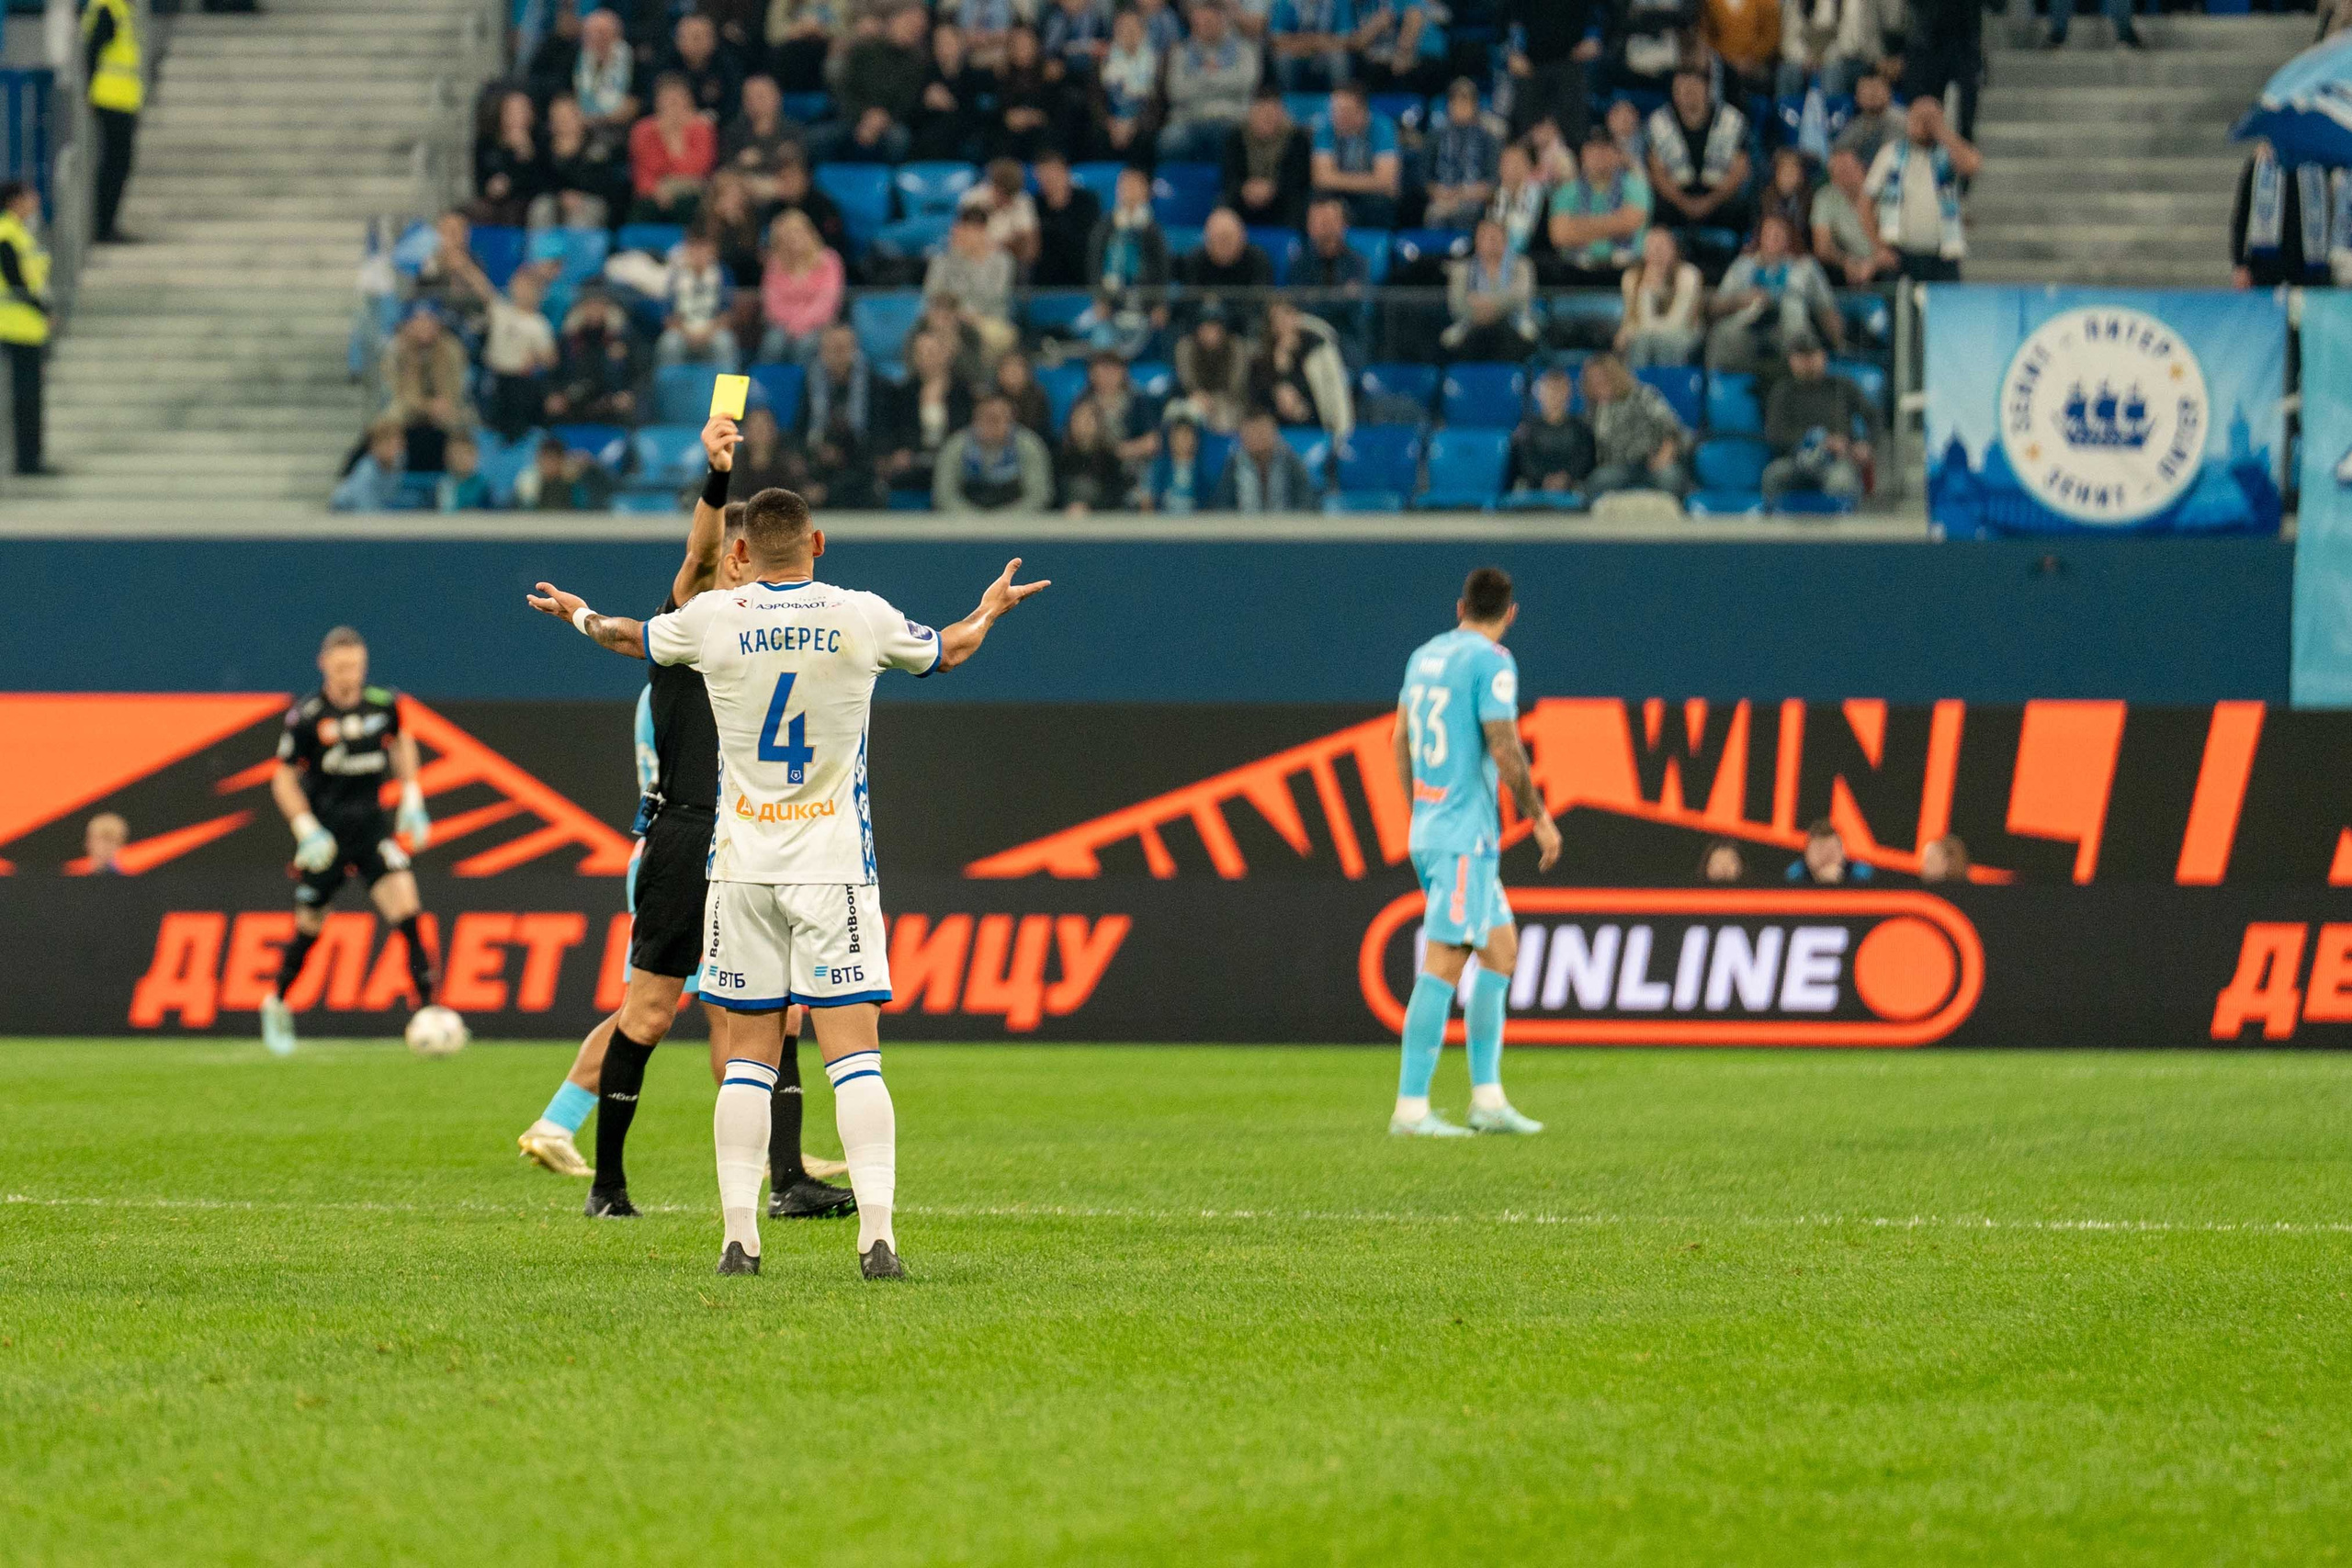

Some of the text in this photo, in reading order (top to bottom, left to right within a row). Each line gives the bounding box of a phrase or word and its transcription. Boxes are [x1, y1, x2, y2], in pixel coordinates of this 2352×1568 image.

[739, 626, 841, 656] КАСЕРЕС
[758, 671, 816, 784] 4
[1408, 683, 1452, 768] 33
[718, 970, 746, 989] ВТБ
[831, 965, 865, 985] ВТБ
[1415, 923, 1849, 1010] INLINE
